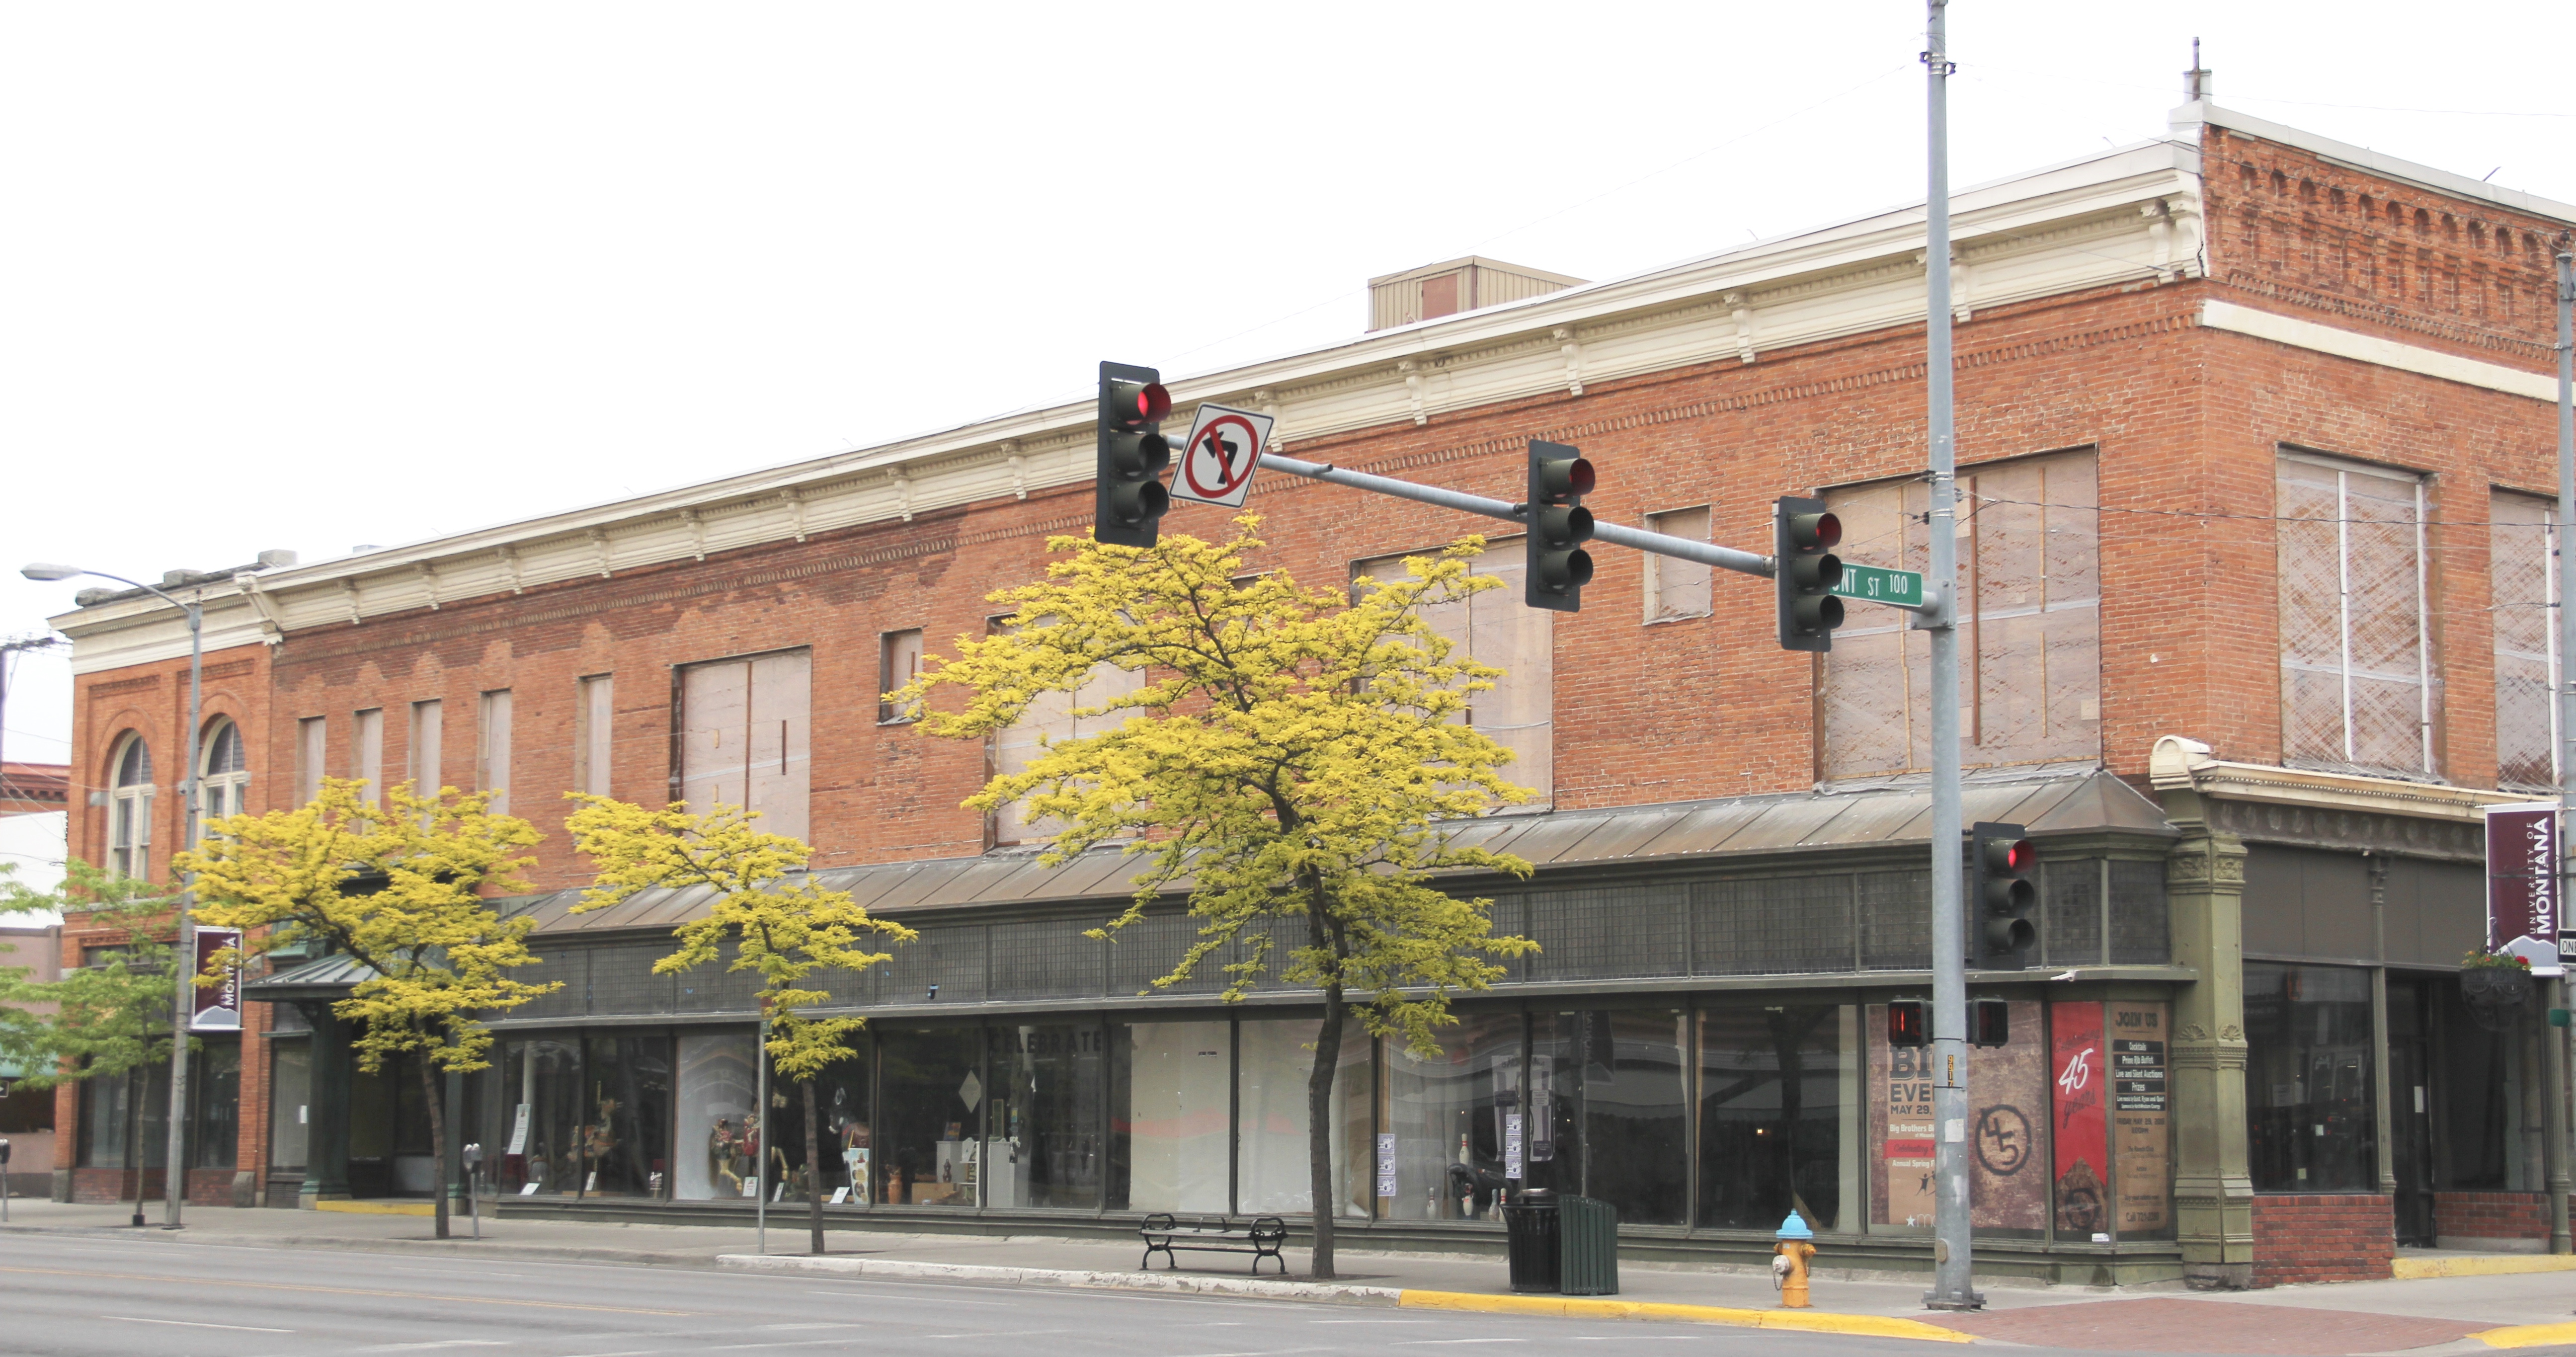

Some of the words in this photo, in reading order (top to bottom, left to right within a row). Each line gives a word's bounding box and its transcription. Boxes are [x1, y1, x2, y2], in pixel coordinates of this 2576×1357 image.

[1832, 568, 1856, 593] NT
[1867, 577, 1880, 596] ST
[1889, 574, 1908, 595] 100
[2527, 823, 2533, 839] OF
[2534, 817, 2551, 934] MONTANA
[226, 937, 236, 1005] MONTA
[2116, 1012, 2141, 1028] JOIN
[2145, 1012, 2158, 1028] US
[1889, 1045, 1933, 1081] BI
[2058, 1048, 2094, 1094] 45
[2115, 1069, 2124, 1078] Live
[2144, 1069, 2163, 1078] Auctions
[1890, 1083, 1934, 1102] EVE
[2132, 1082, 2145, 1091] Prizes
[1890, 1105, 1913, 1115] MAY
[1917, 1105, 1932, 1116] 29,
[1890, 1124, 1899, 1133] Big
[1912, 1160, 1929, 1168] Spring
